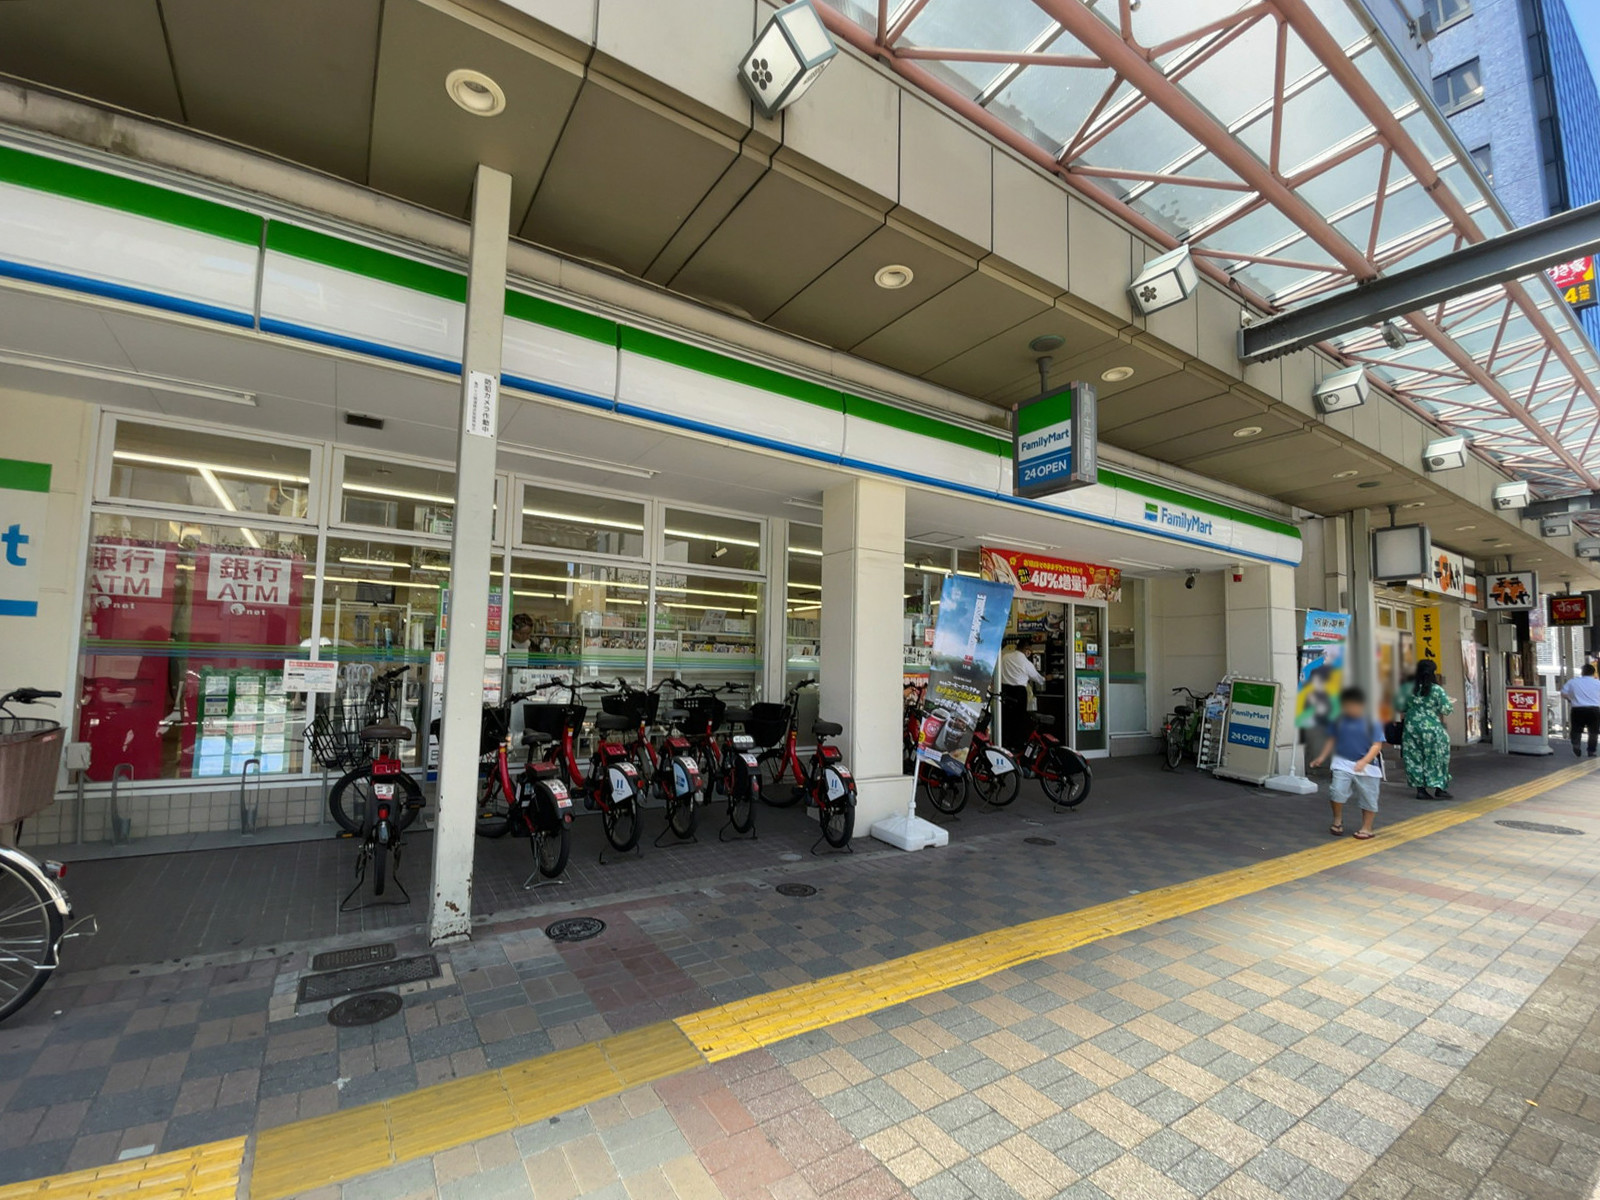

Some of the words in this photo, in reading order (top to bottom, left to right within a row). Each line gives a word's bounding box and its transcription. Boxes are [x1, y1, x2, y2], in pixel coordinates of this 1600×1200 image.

[1021, 428, 1070, 452] FamilyMart
[1161, 507, 1213, 536] FamilyMart
[219, 556, 283, 583] 銀行
[1496, 576, 1522, 588] 天丼
[218, 583, 279, 603] ATM
[1489, 591, 1530, 605] てんや
[1511, 692, 1535, 705] すき家
[1231, 708, 1270, 721] FamilyMart
[1511, 711, 1533, 719] 牛丼
